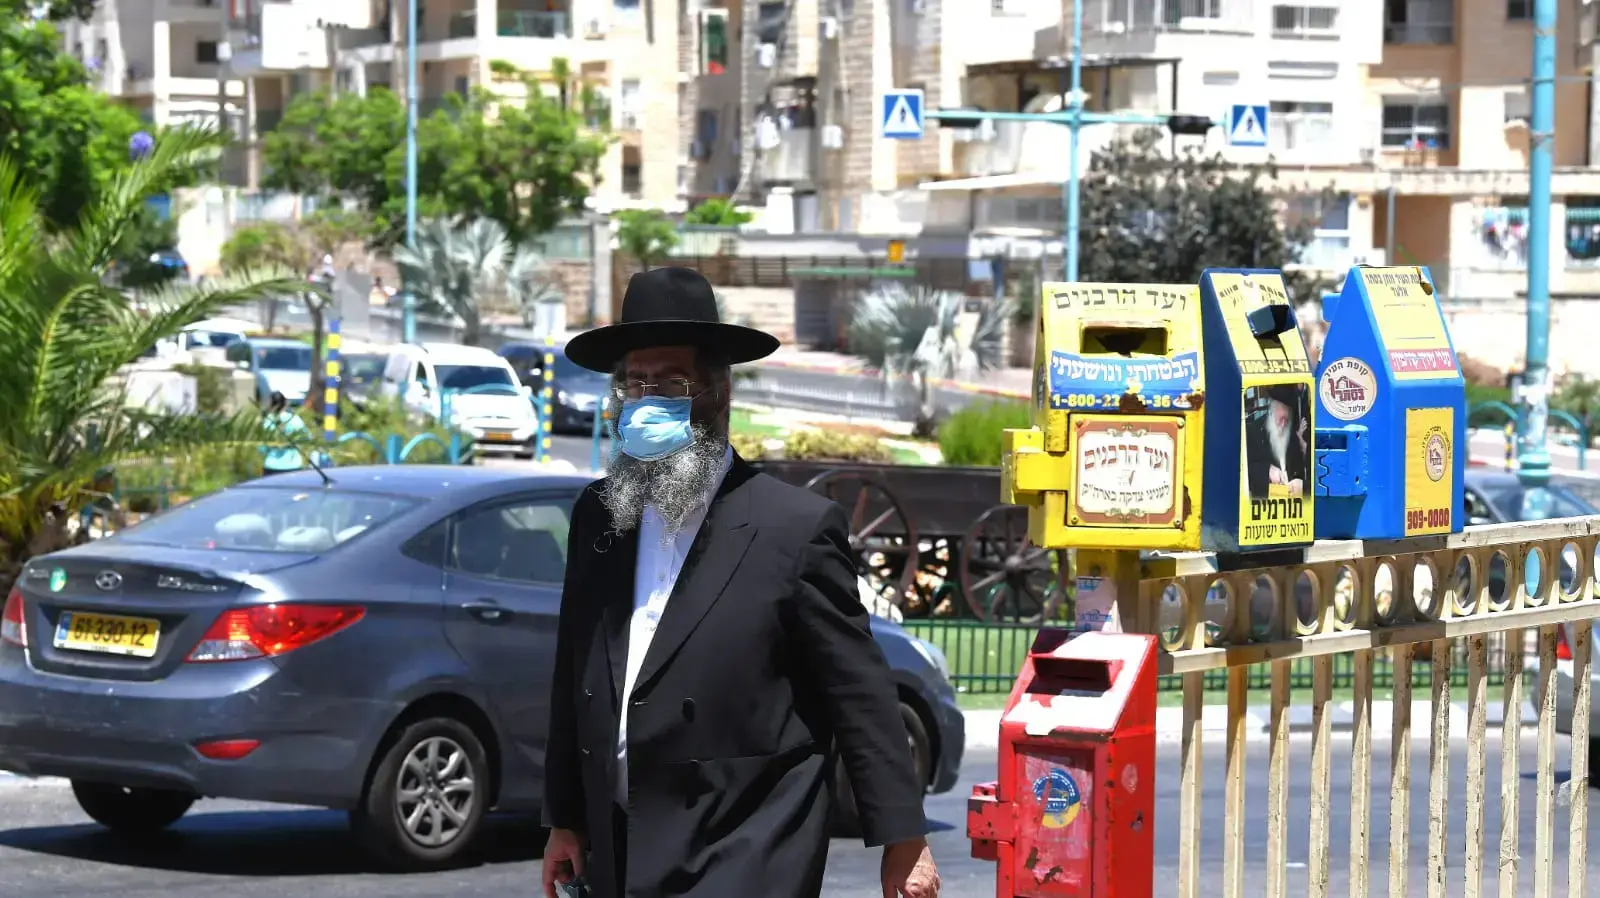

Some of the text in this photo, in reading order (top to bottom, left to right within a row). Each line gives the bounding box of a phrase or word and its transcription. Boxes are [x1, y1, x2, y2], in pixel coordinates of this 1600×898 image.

[1054, 288, 1187, 310] ועד הרבנים
[1052, 357, 1196, 383] הבטחתי ונושעתי
[1324, 361, 1369, 378] קופת העיר
[1084, 444, 1170, 472] ועד הרבנים
[1251, 497, 1303, 520] תורמים
[1407, 508, 1450, 530] 909-0000
[1244, 522, 1309, 540] ורואים ישועות
